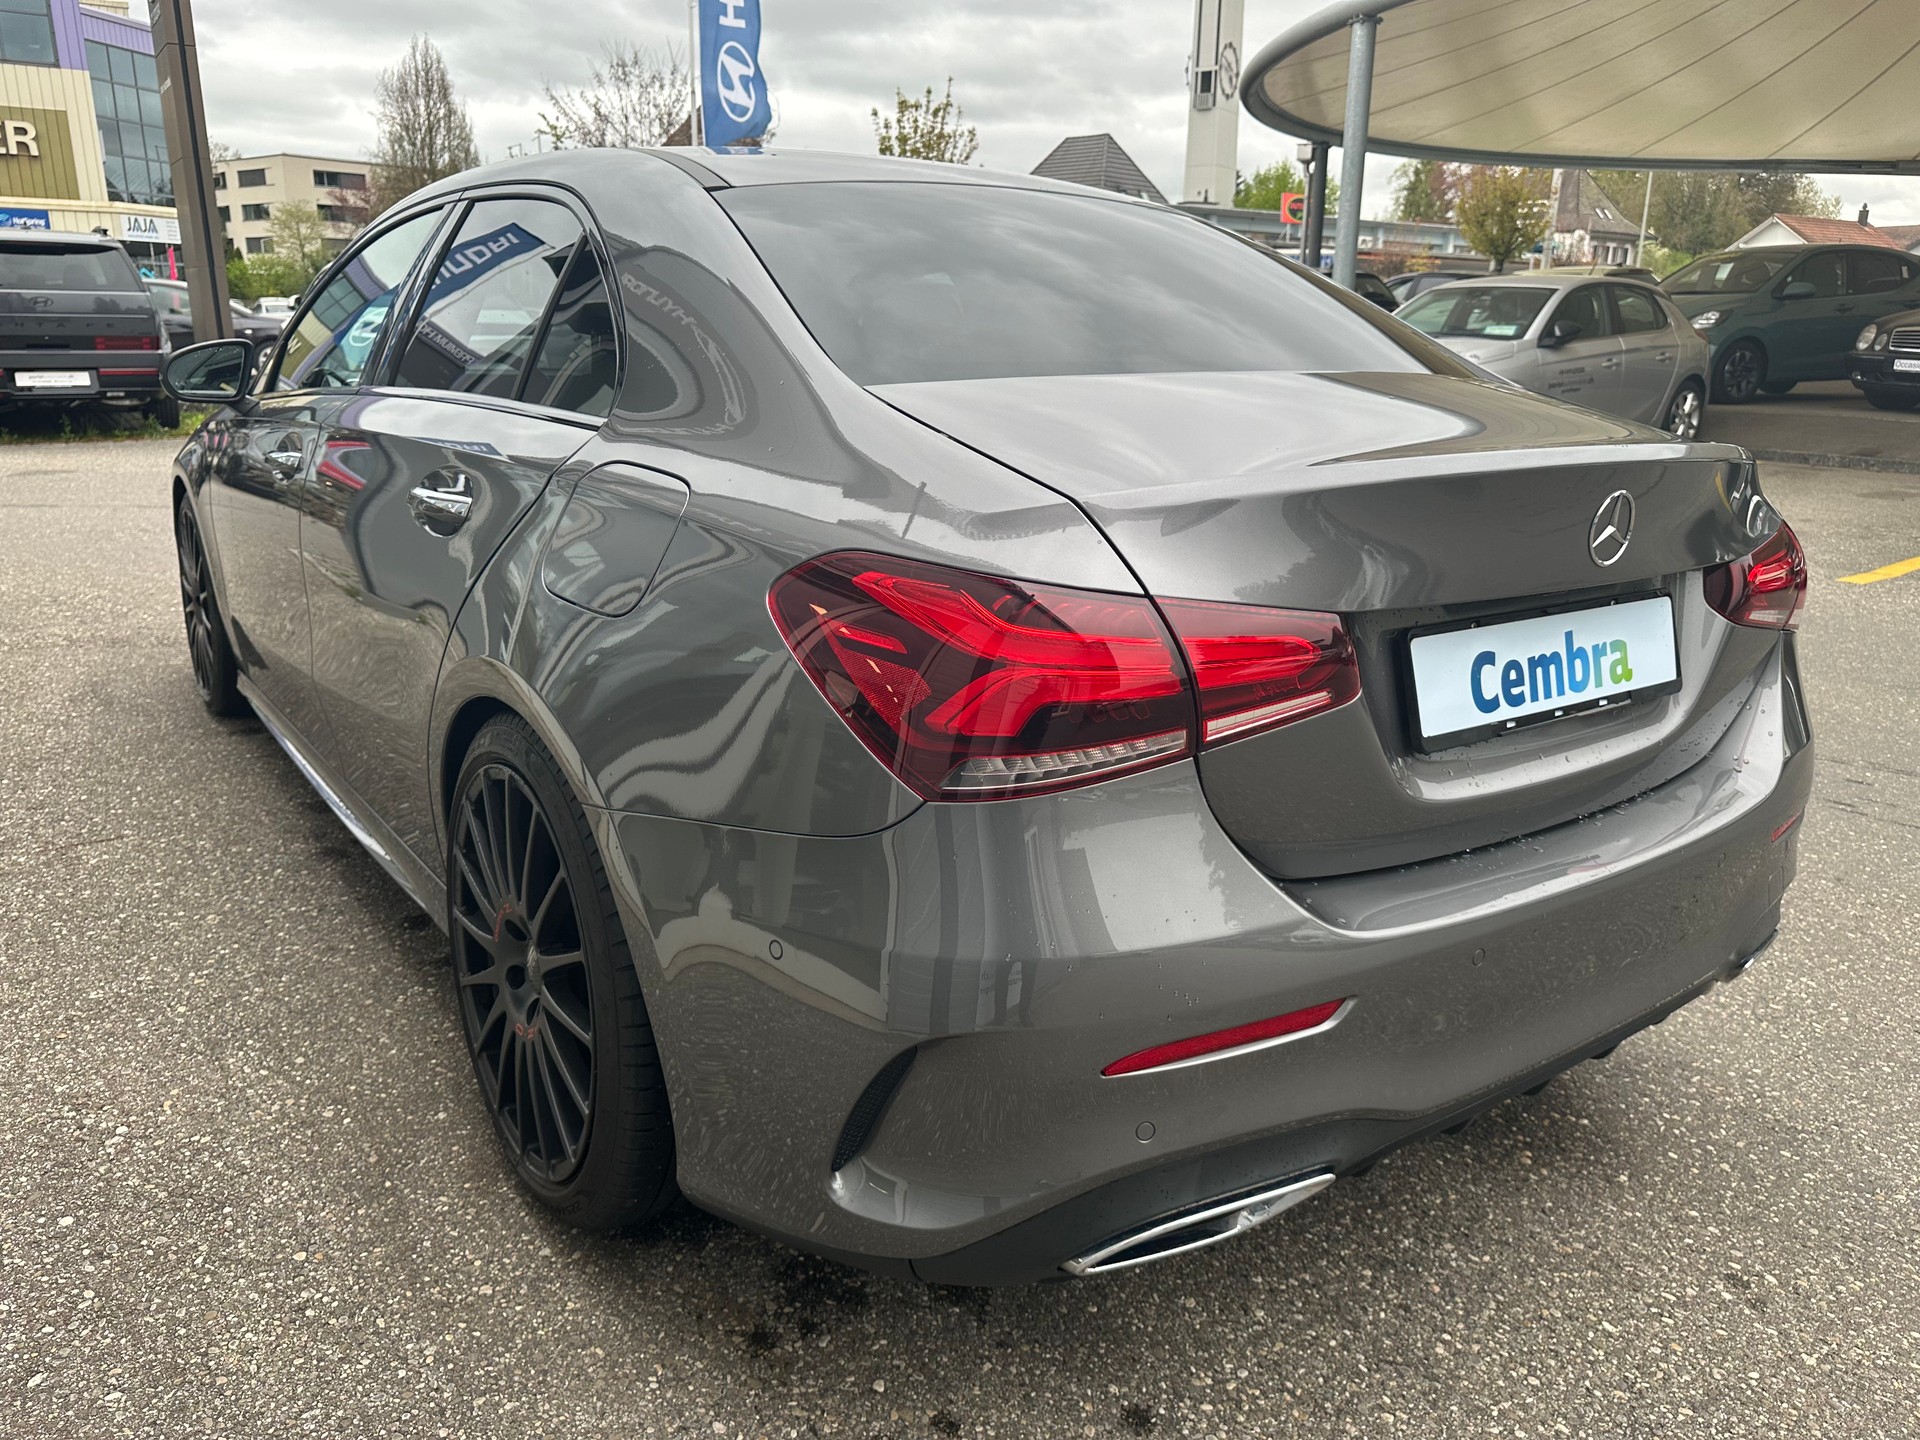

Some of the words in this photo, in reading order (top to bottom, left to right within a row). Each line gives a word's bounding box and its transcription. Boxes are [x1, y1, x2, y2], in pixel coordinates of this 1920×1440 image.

[0, 120, 39, 156] R
[127, 216, 159, 235] JAJA
[1471, 630, 1633, 714] Cembra
